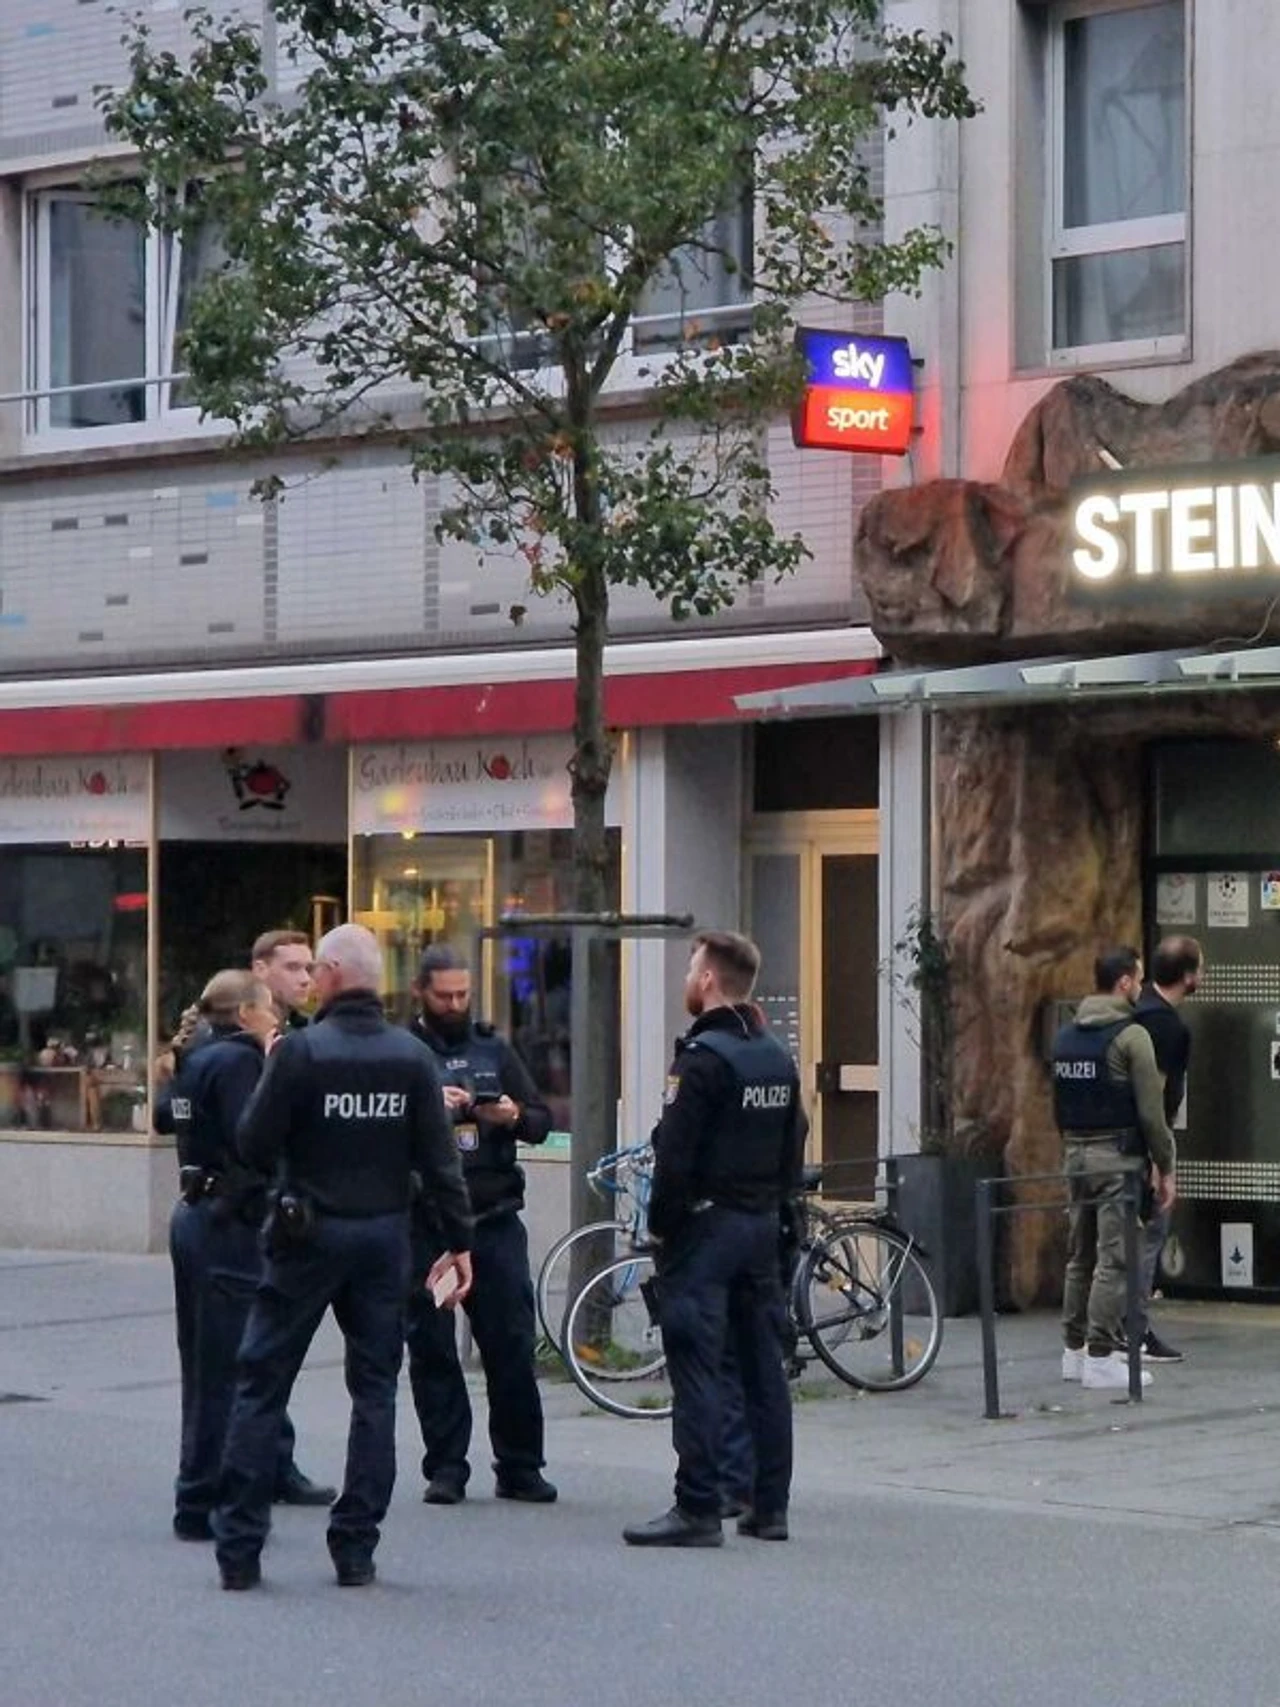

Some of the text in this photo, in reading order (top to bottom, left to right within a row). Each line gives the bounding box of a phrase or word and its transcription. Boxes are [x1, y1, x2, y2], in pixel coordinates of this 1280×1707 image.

[832, 343, 885, 388] sky
[827, 406, 889, 432] sport
[1055, 1061, 1096, 1079] POLIZEI
[324, 1092, 408, 1119] POLIZEI
[742, 1086, 791, 1108] POLIZEI
